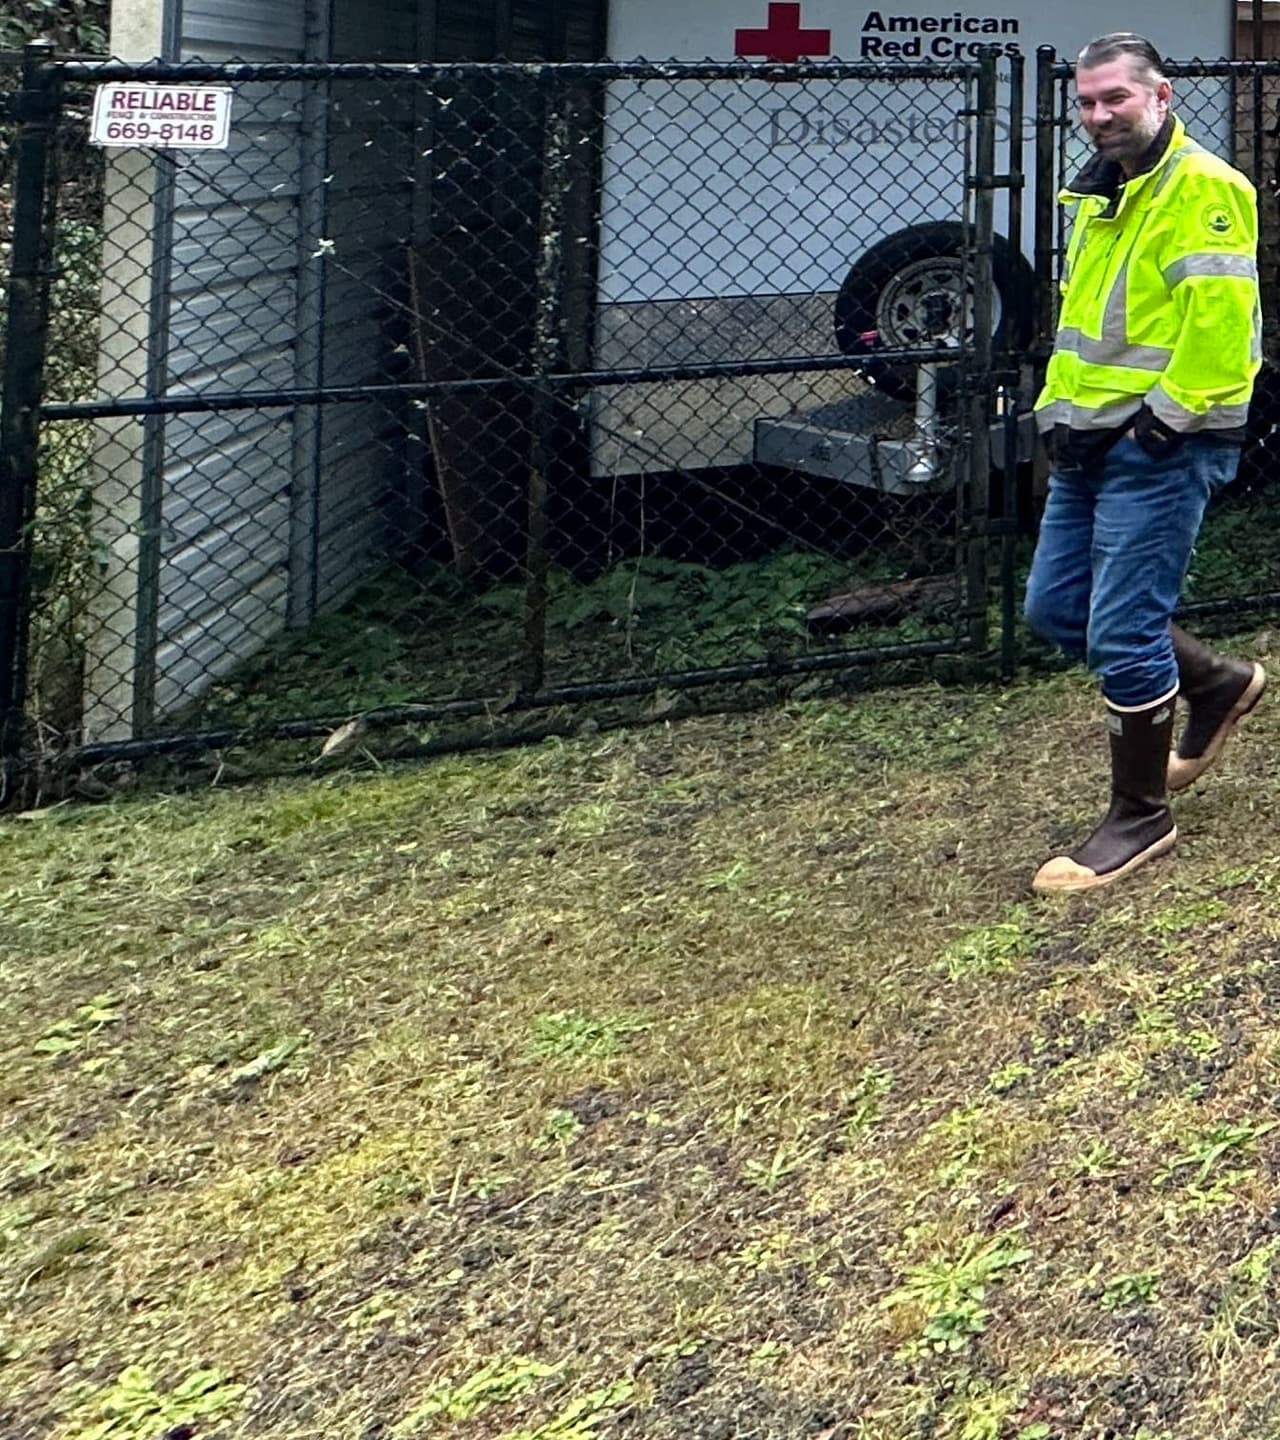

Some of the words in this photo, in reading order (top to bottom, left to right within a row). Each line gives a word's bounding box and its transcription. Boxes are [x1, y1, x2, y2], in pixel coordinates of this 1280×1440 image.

[861, 11, 1019, 34] American
[860, 37, 921, 58] Red
[111, 91, 217, 111] RELIABLE
[107, 122, 213, 141] 669-8148
[769, 109, 970, 146] Disaster
